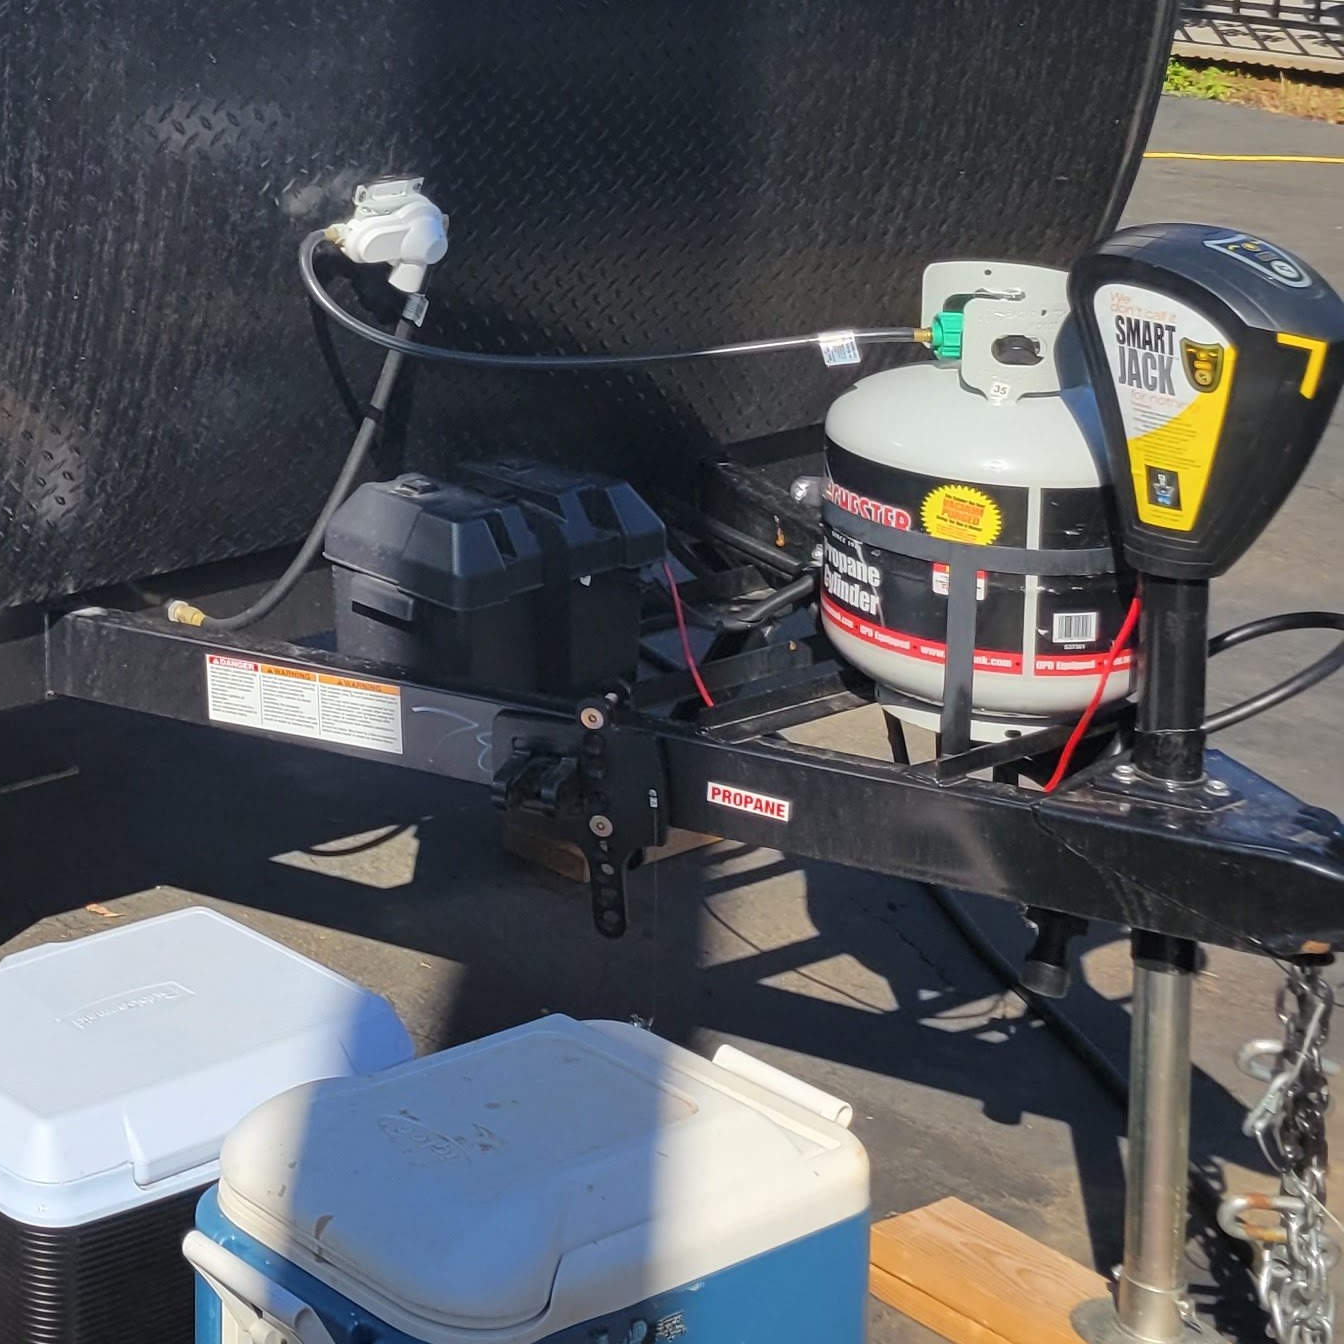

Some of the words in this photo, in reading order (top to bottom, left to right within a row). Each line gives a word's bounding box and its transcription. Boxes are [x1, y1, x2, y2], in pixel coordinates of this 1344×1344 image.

[1115, 314, 1176, 356] SMART
[1118, 345, 1176, 397] JACK
[993, 384, 1007, 396] 35
[824, 536, 881, 587] Propane
[824, 563, 879, 616] Cylinder
[219, 658, 255, 671] DANGER
[273, 667, 311, 680] WARNING
[344, 679, 382, 692] WARNING
[711, 786, 787, 818] PROPANE
